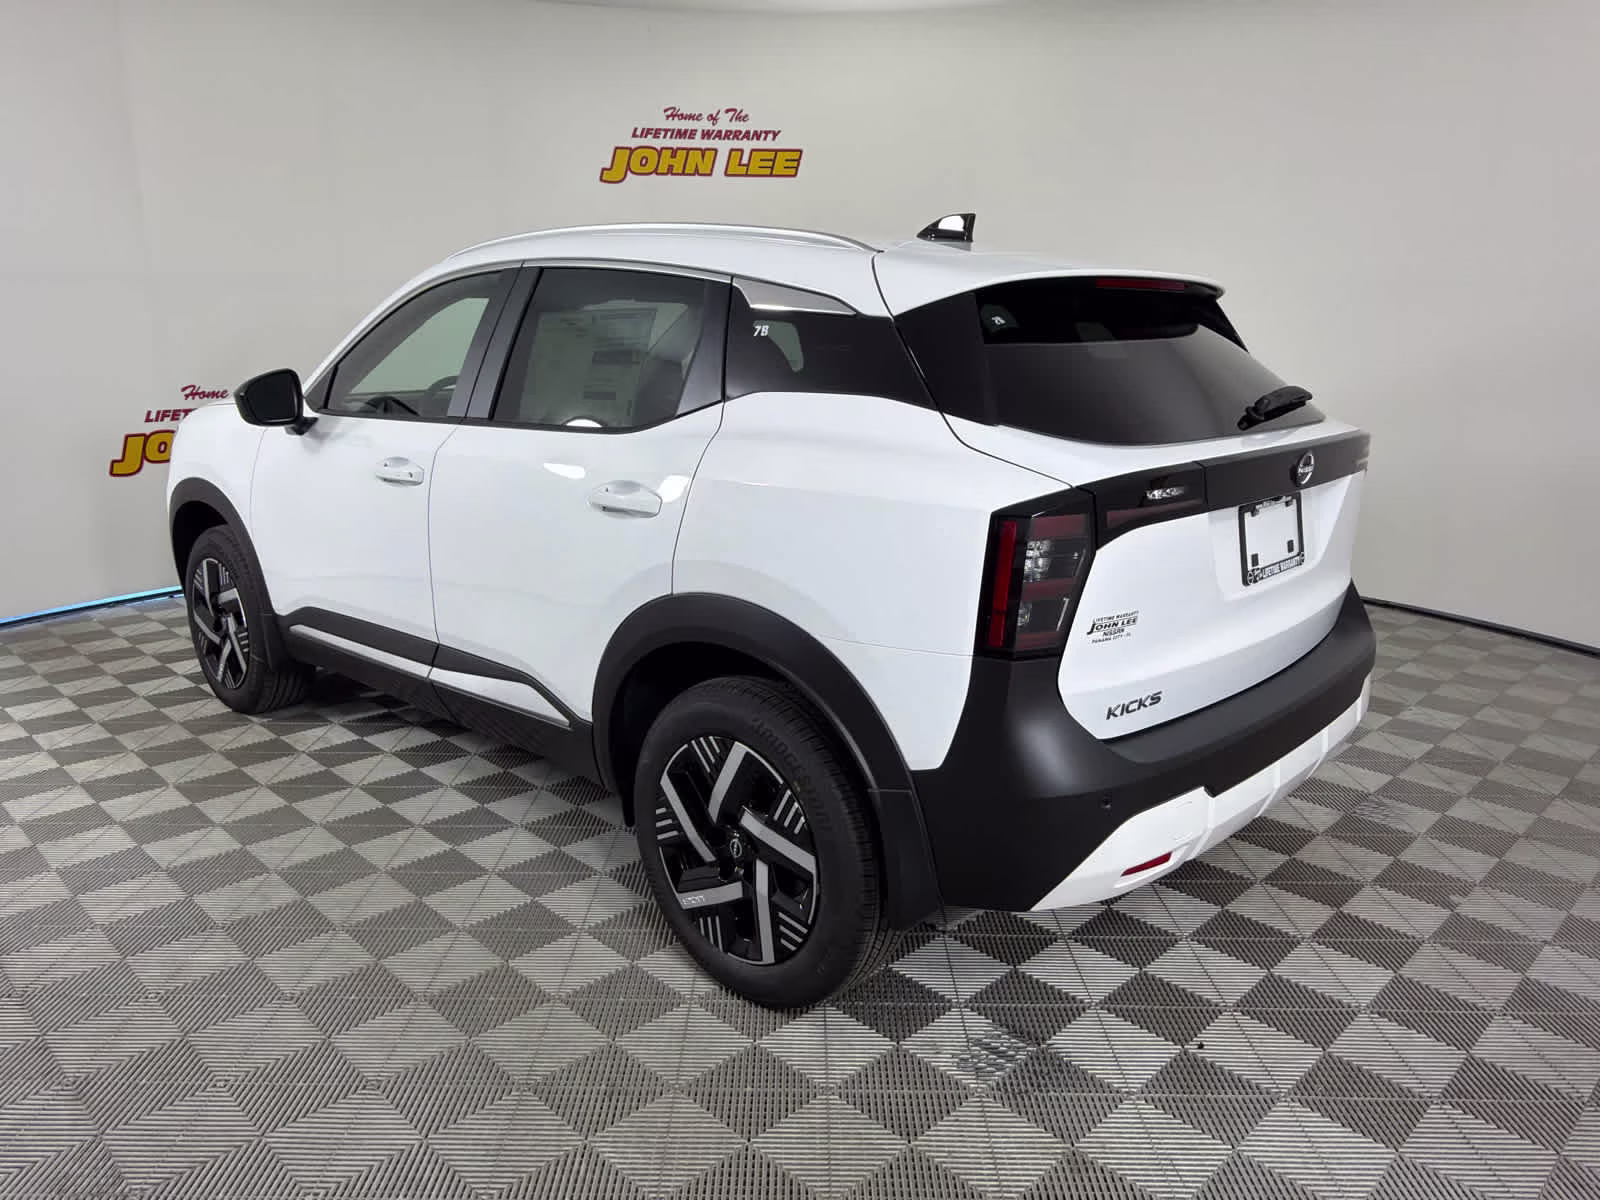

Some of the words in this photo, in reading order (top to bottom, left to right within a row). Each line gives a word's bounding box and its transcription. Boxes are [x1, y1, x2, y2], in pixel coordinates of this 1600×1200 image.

[663, 106, 704, 122] Home
[706, 109, 721, 126] of
[724, 107, 750, 123] The
[632, 127, 698, 140] LIFETIME
[700, 128, 782, 141] WARRANTY
[600, 145, 718, 184] JOHN
[724, 148, 803, 178] LEE
[181, 384, 229, 401] Home
[1086, 622, 1119, 635] JOHN
[1120, 616, 1138, 627] LEE
[1106, 691, 1162, 720] KICKS
